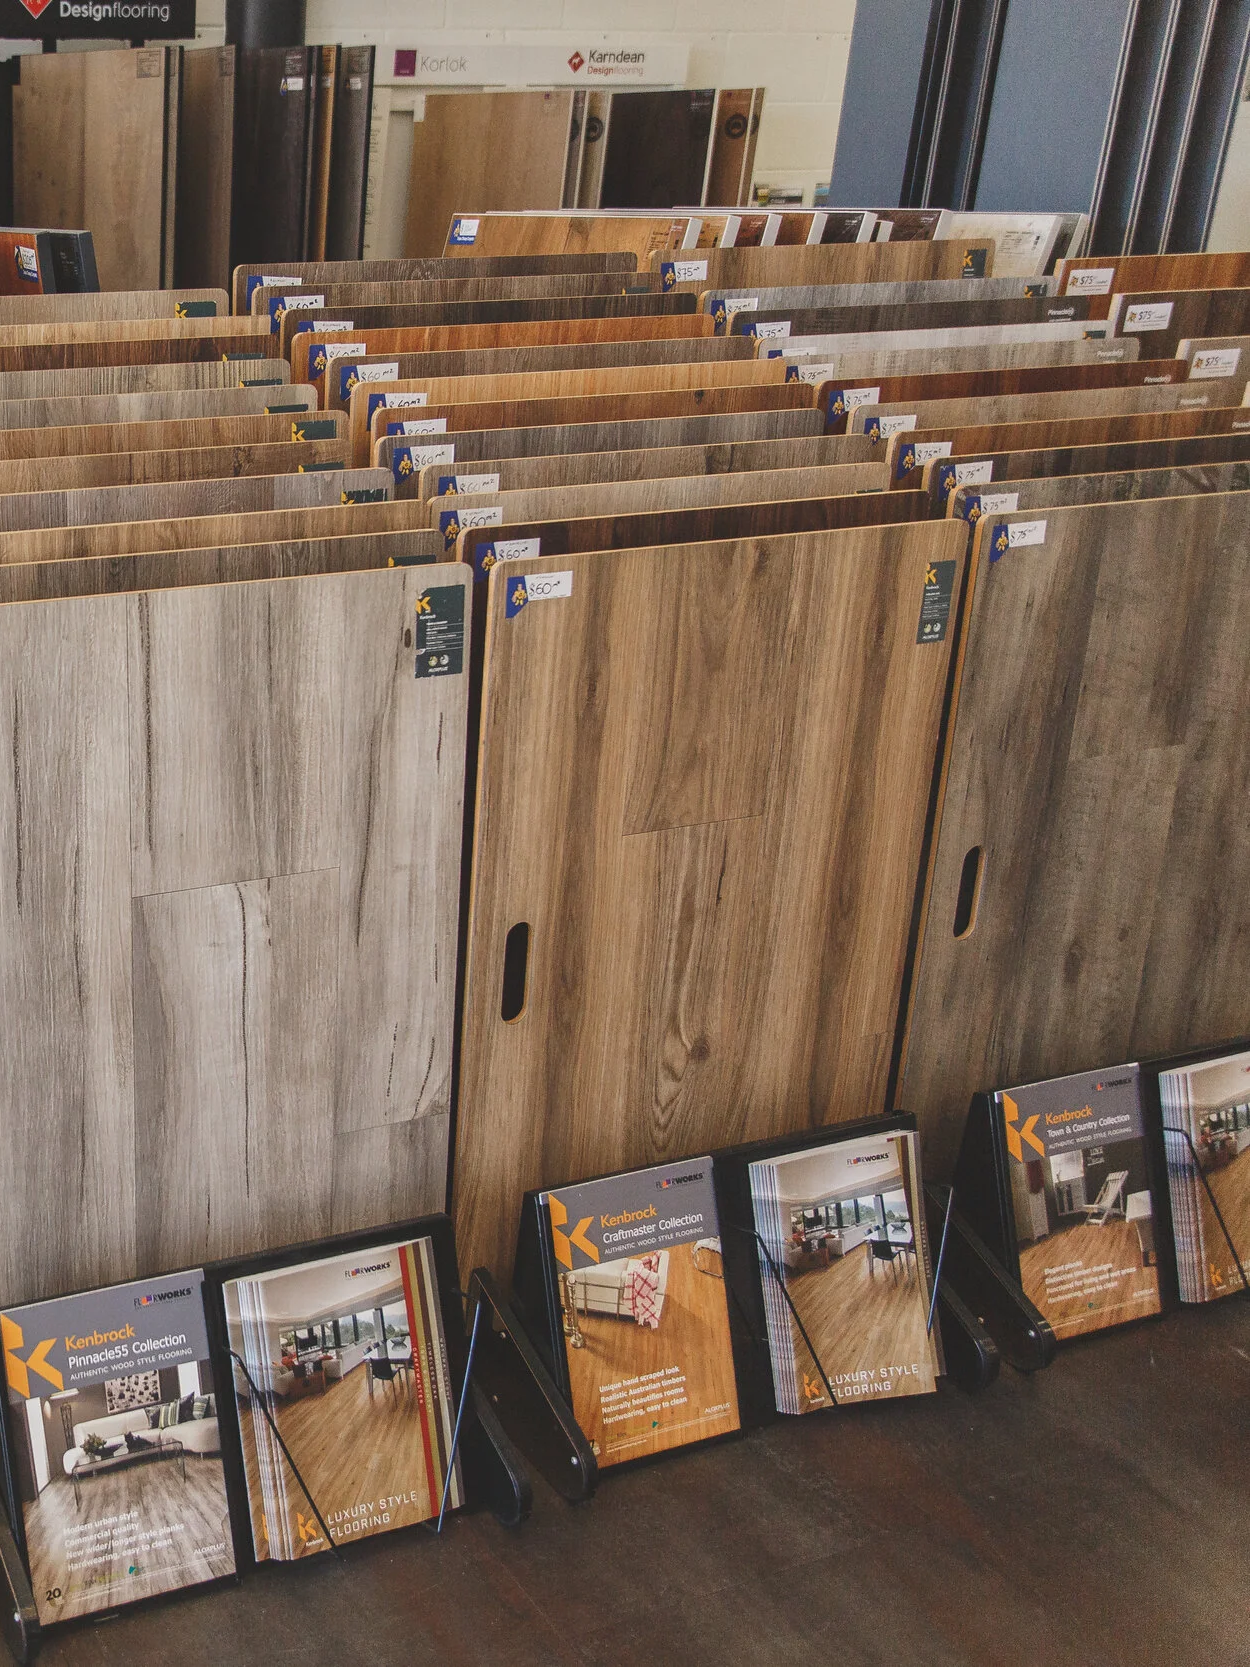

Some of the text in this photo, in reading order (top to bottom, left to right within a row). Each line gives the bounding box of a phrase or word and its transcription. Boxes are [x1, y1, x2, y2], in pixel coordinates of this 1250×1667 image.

[60, 1, 170, 22] Designflooring
[420, 56, 467, 73] Korlok
[587, 65, 644, 76] Designflooring
[588, 50, 645, 63] Karndean
[1045, 1104, 1093, 1125] Kenbrock
[1047, 1128, 1065, 1138] Town
[1072, 1120, 1098, 1132] Country
[1098, 1114, 1130, 1127] Collection
[600, 1203, 658, 1228] Kenbrock
[602, 1213, 703, 1244] Craftmaster Collection
[604, 1226, 704, 1255] AUTHENTIC WOOD STYLE FLOORING
[64, 1323, 136, 1351] Kenbrock
[68, 1333, 186, 1369] Pinnacle55 Collection
[69, 1347, 193, 1381] AUTHENTIC WOOD STYLE FLOORING
[828, 1363, 919, 1386] LUXURY STYLE
[599, 1365, 680, 1394] Unique hand scraped look
[600, 1375, 687, 1404] Realistic Australian timbers
[601, 1386, 684, 1414] Naturally beautifies rooms
[603, 1408, 646, 1425] Hardwearing,
[646, 1404, 661, 1414] easy
[670, 1396, 688, 1406] clean
[94, 1515, 118, 1528] urban
[118, 1510, 139, 1523] style
[327, 1490, 418, 1525] LUXURY STYLE
[64, 1522, 140, 1548] Commercial quality
[329, 1512, 391, 1538] FLOORING
[66, 1523, 185, 1560] New wider/longer style planks
[67, 1537, 173, 1572] Hardwearing, easy to clean
